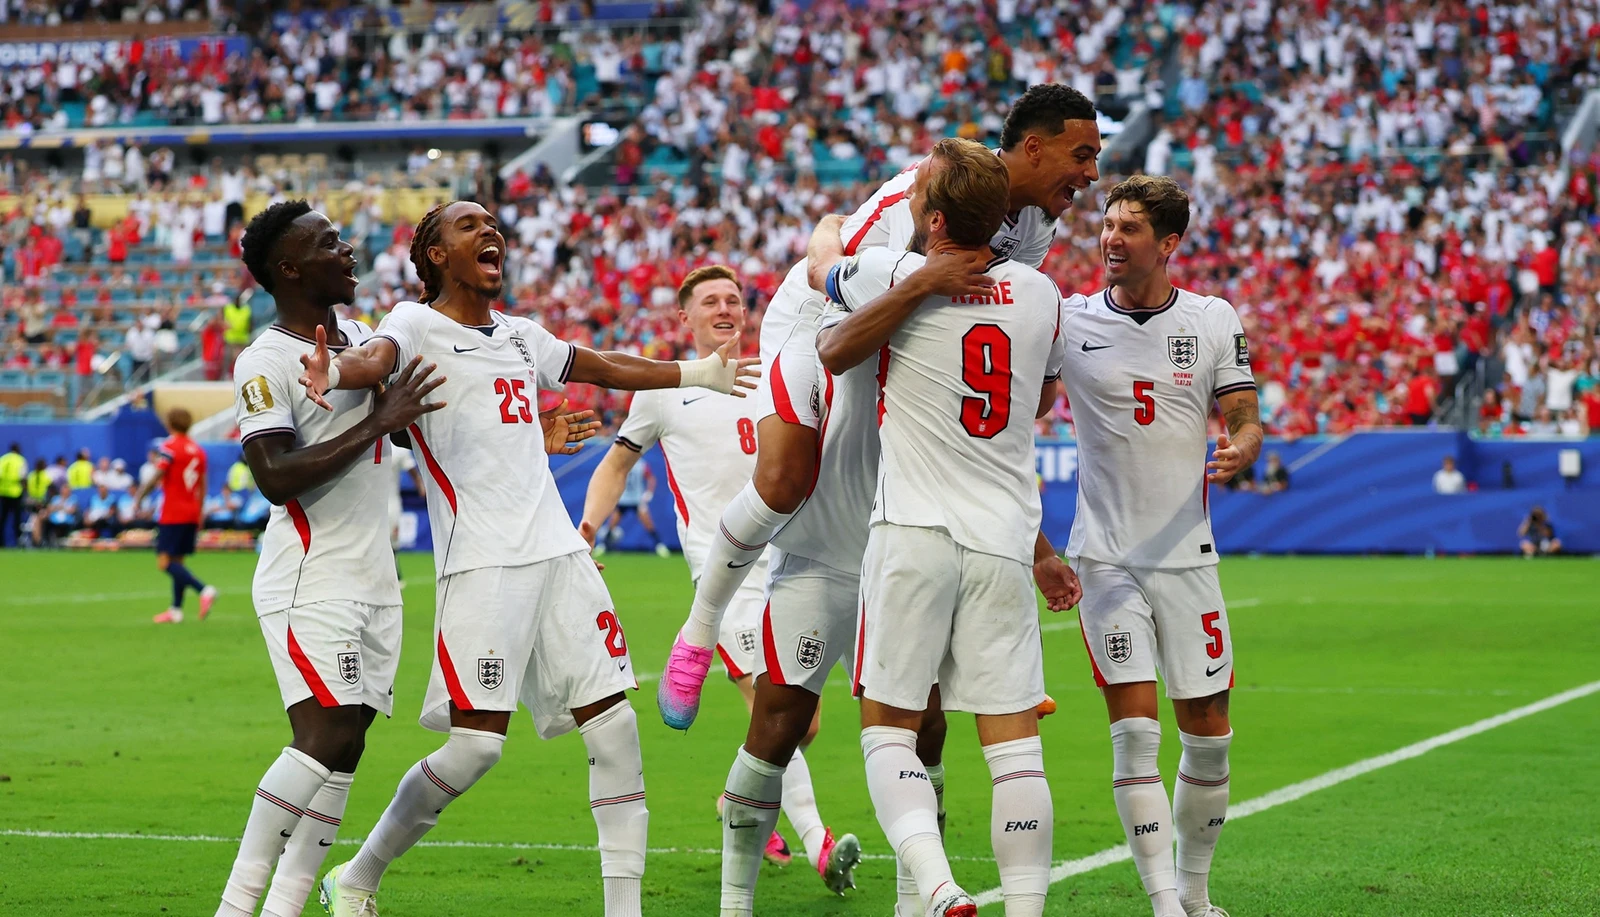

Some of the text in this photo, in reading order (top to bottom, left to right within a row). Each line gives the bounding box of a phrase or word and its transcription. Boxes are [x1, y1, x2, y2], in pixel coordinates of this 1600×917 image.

[959, 323, 1013, 439] 9
[493, 377, 533, 424] 25
[1133, 381, 1156, 426] 5
[737, 417, 757, 455] 8
[1201, 610, 1224, 660] 5
[899, 770, 928, 781] ENG
[1004, 819, 1039, 833] ENG
[1134, 821, 1159, 836] ENG
[1208, 816, 1226, 827] EN
